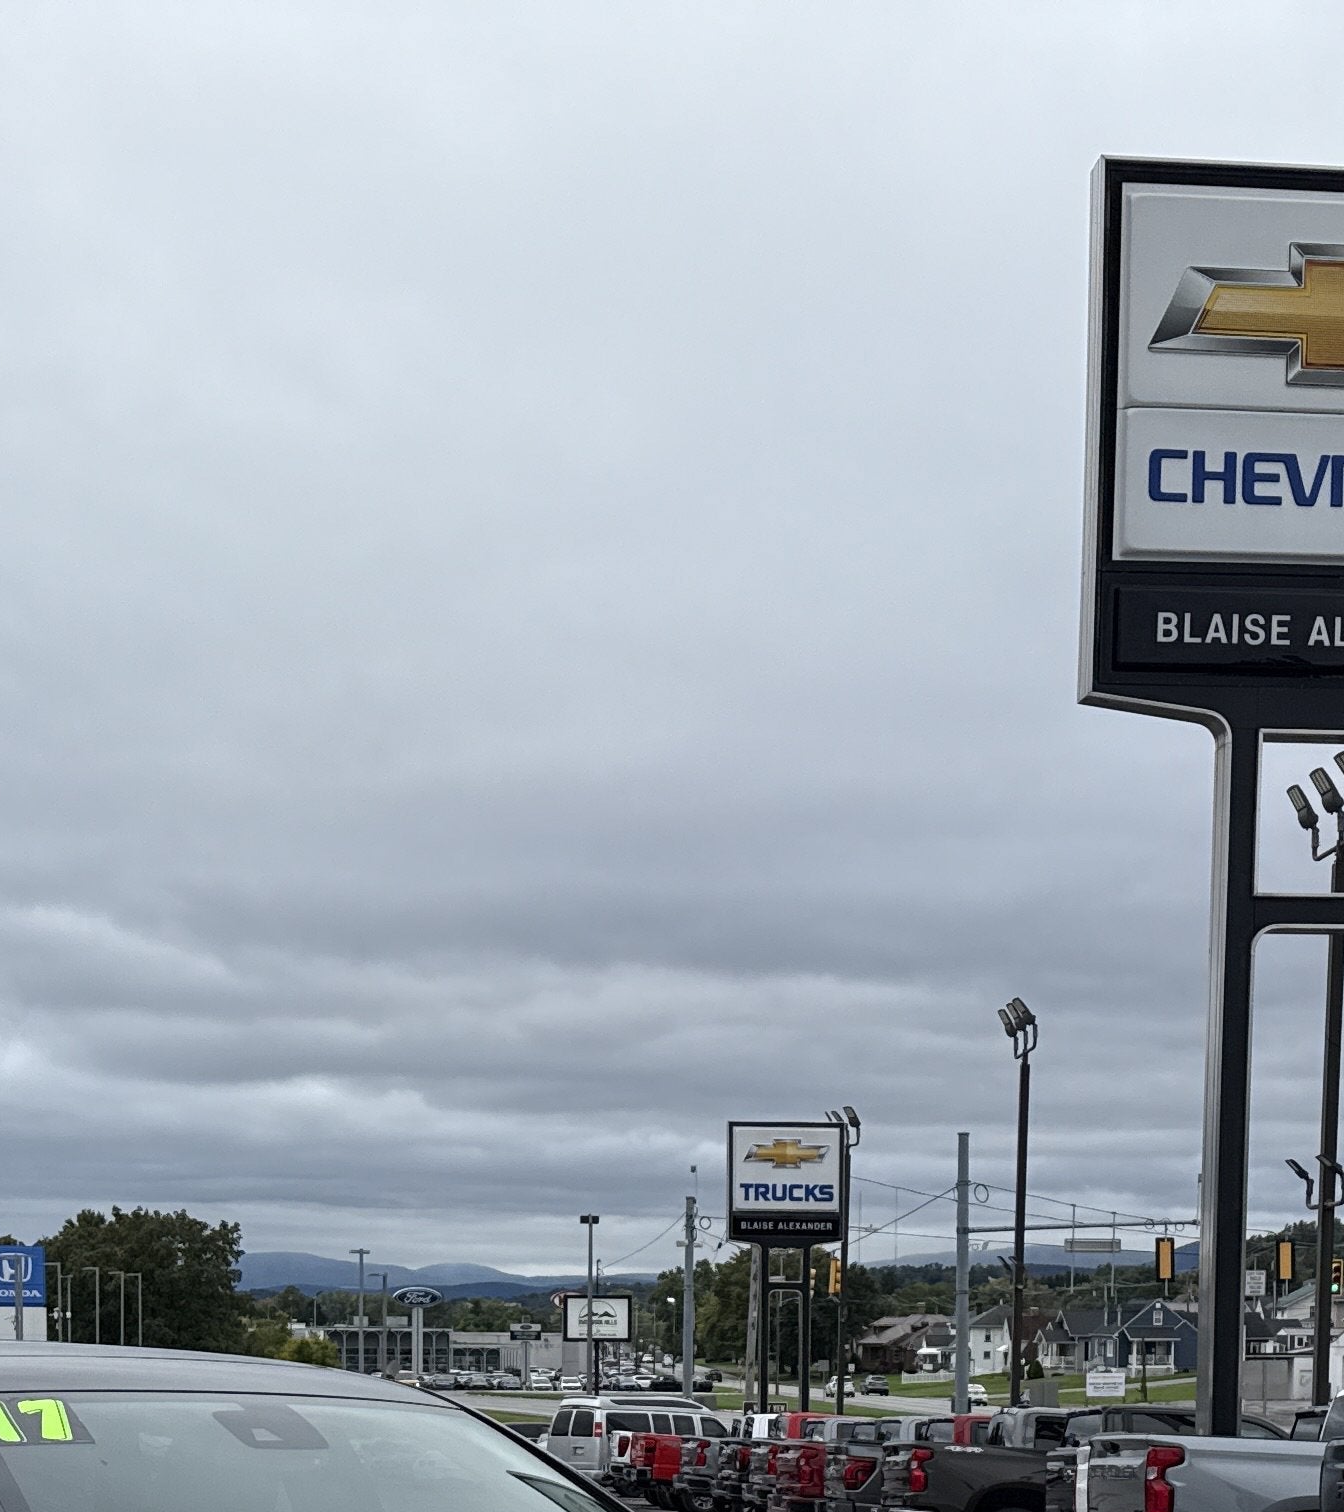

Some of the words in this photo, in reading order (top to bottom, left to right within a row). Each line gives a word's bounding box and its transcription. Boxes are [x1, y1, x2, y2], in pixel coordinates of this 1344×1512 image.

[1156, 611, 1291, 648] BLAISE
[739, 1182, 835, 1203] TRUCKS
[740, 1220, 775, 1231] BLAISE
[777, 1221, 833, 1232] ALEXANDER
[403, 1291, 433, 1304] Ford
